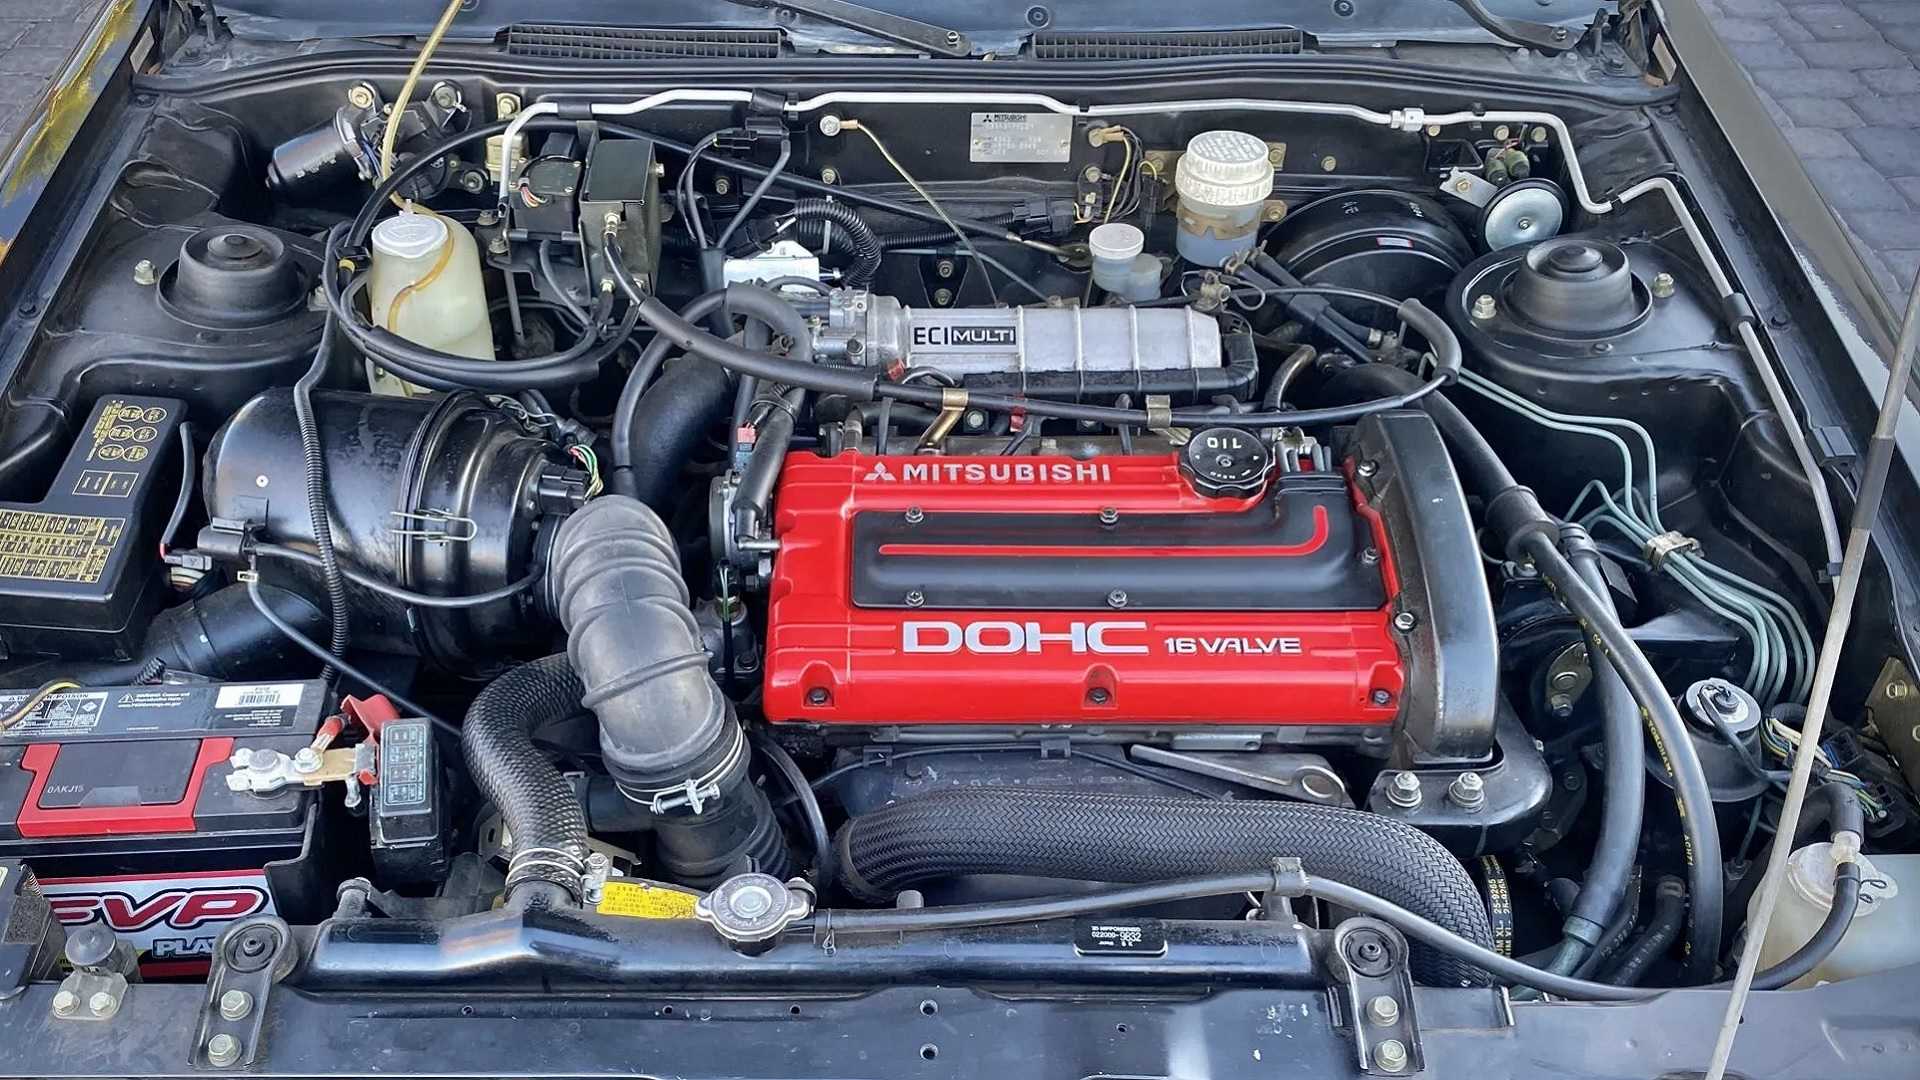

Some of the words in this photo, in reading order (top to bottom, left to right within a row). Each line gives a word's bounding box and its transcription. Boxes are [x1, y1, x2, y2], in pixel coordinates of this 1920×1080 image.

[914, 327, 948, 345] ECI
[953, 329, 1014, 342] MULTI
[1207, 437, 1242, 449] OIL
[903, 463, 1111, 482] MITSUBISHI
[903, 621, 1149, 654] DOHC
